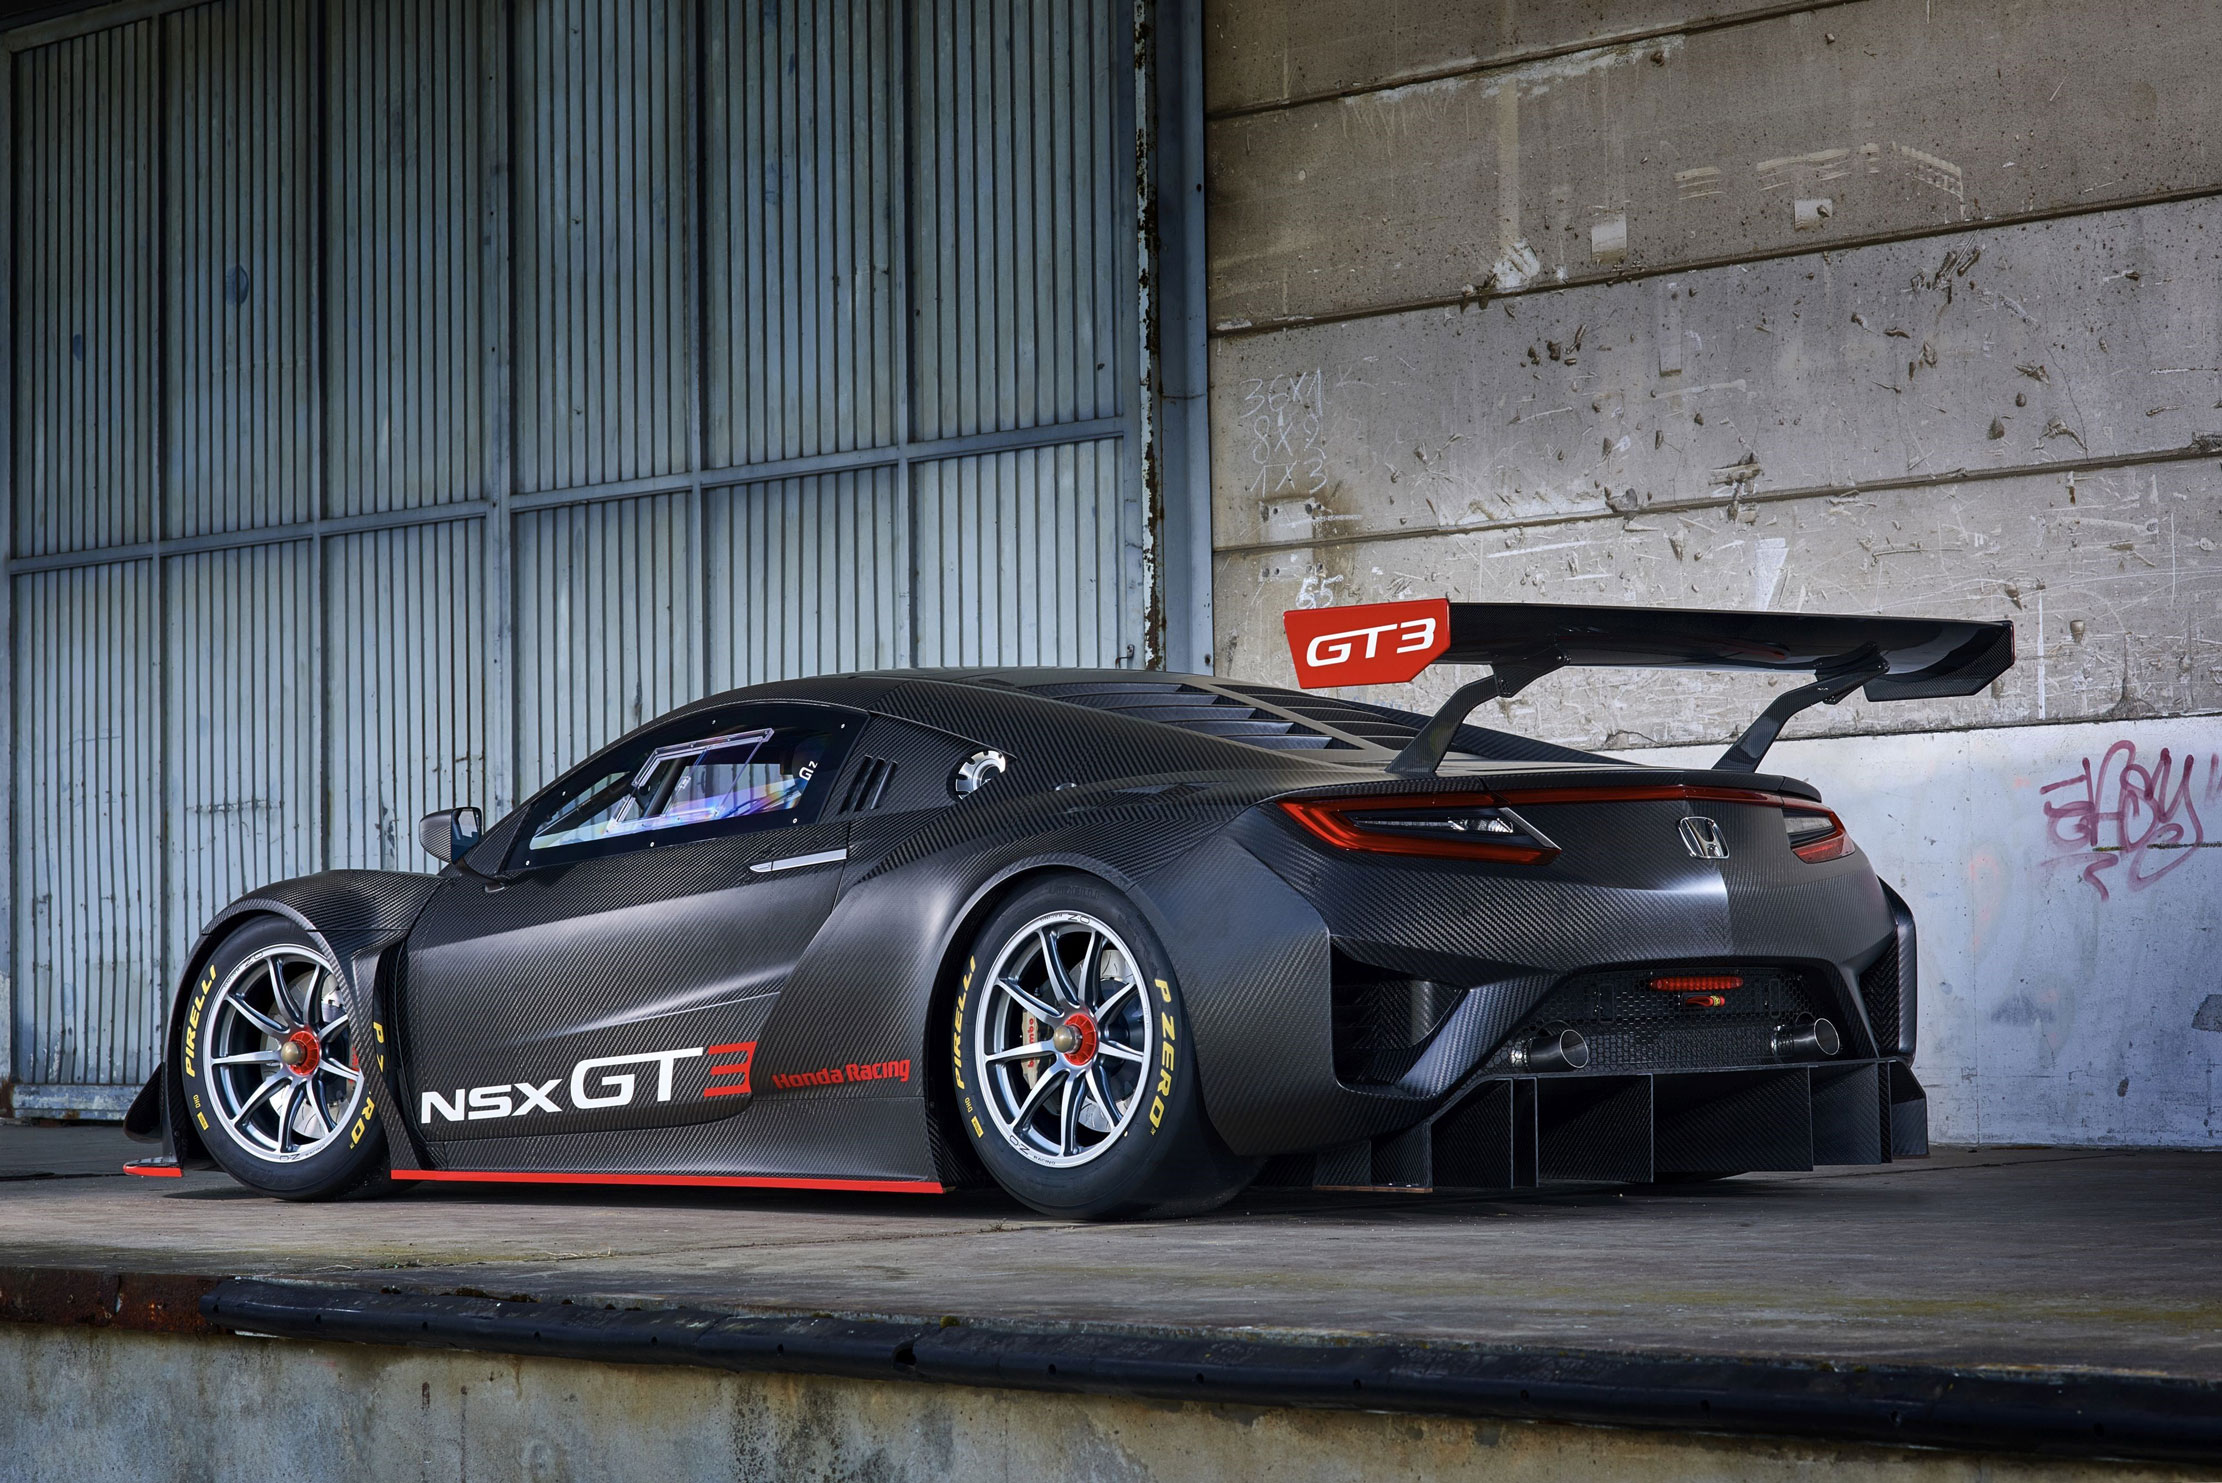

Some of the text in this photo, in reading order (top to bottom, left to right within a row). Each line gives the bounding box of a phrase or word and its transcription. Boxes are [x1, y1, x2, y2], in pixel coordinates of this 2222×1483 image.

[1306, 617, 1437, 668] GT3
[185, 964, 217, 1078] PIRELLI
[772, 1059, 910, 1088] Honda Racing
[953, 955, 976, 1090] PIRELLI
[1149, 1012, 1175, 1128] ZERO
